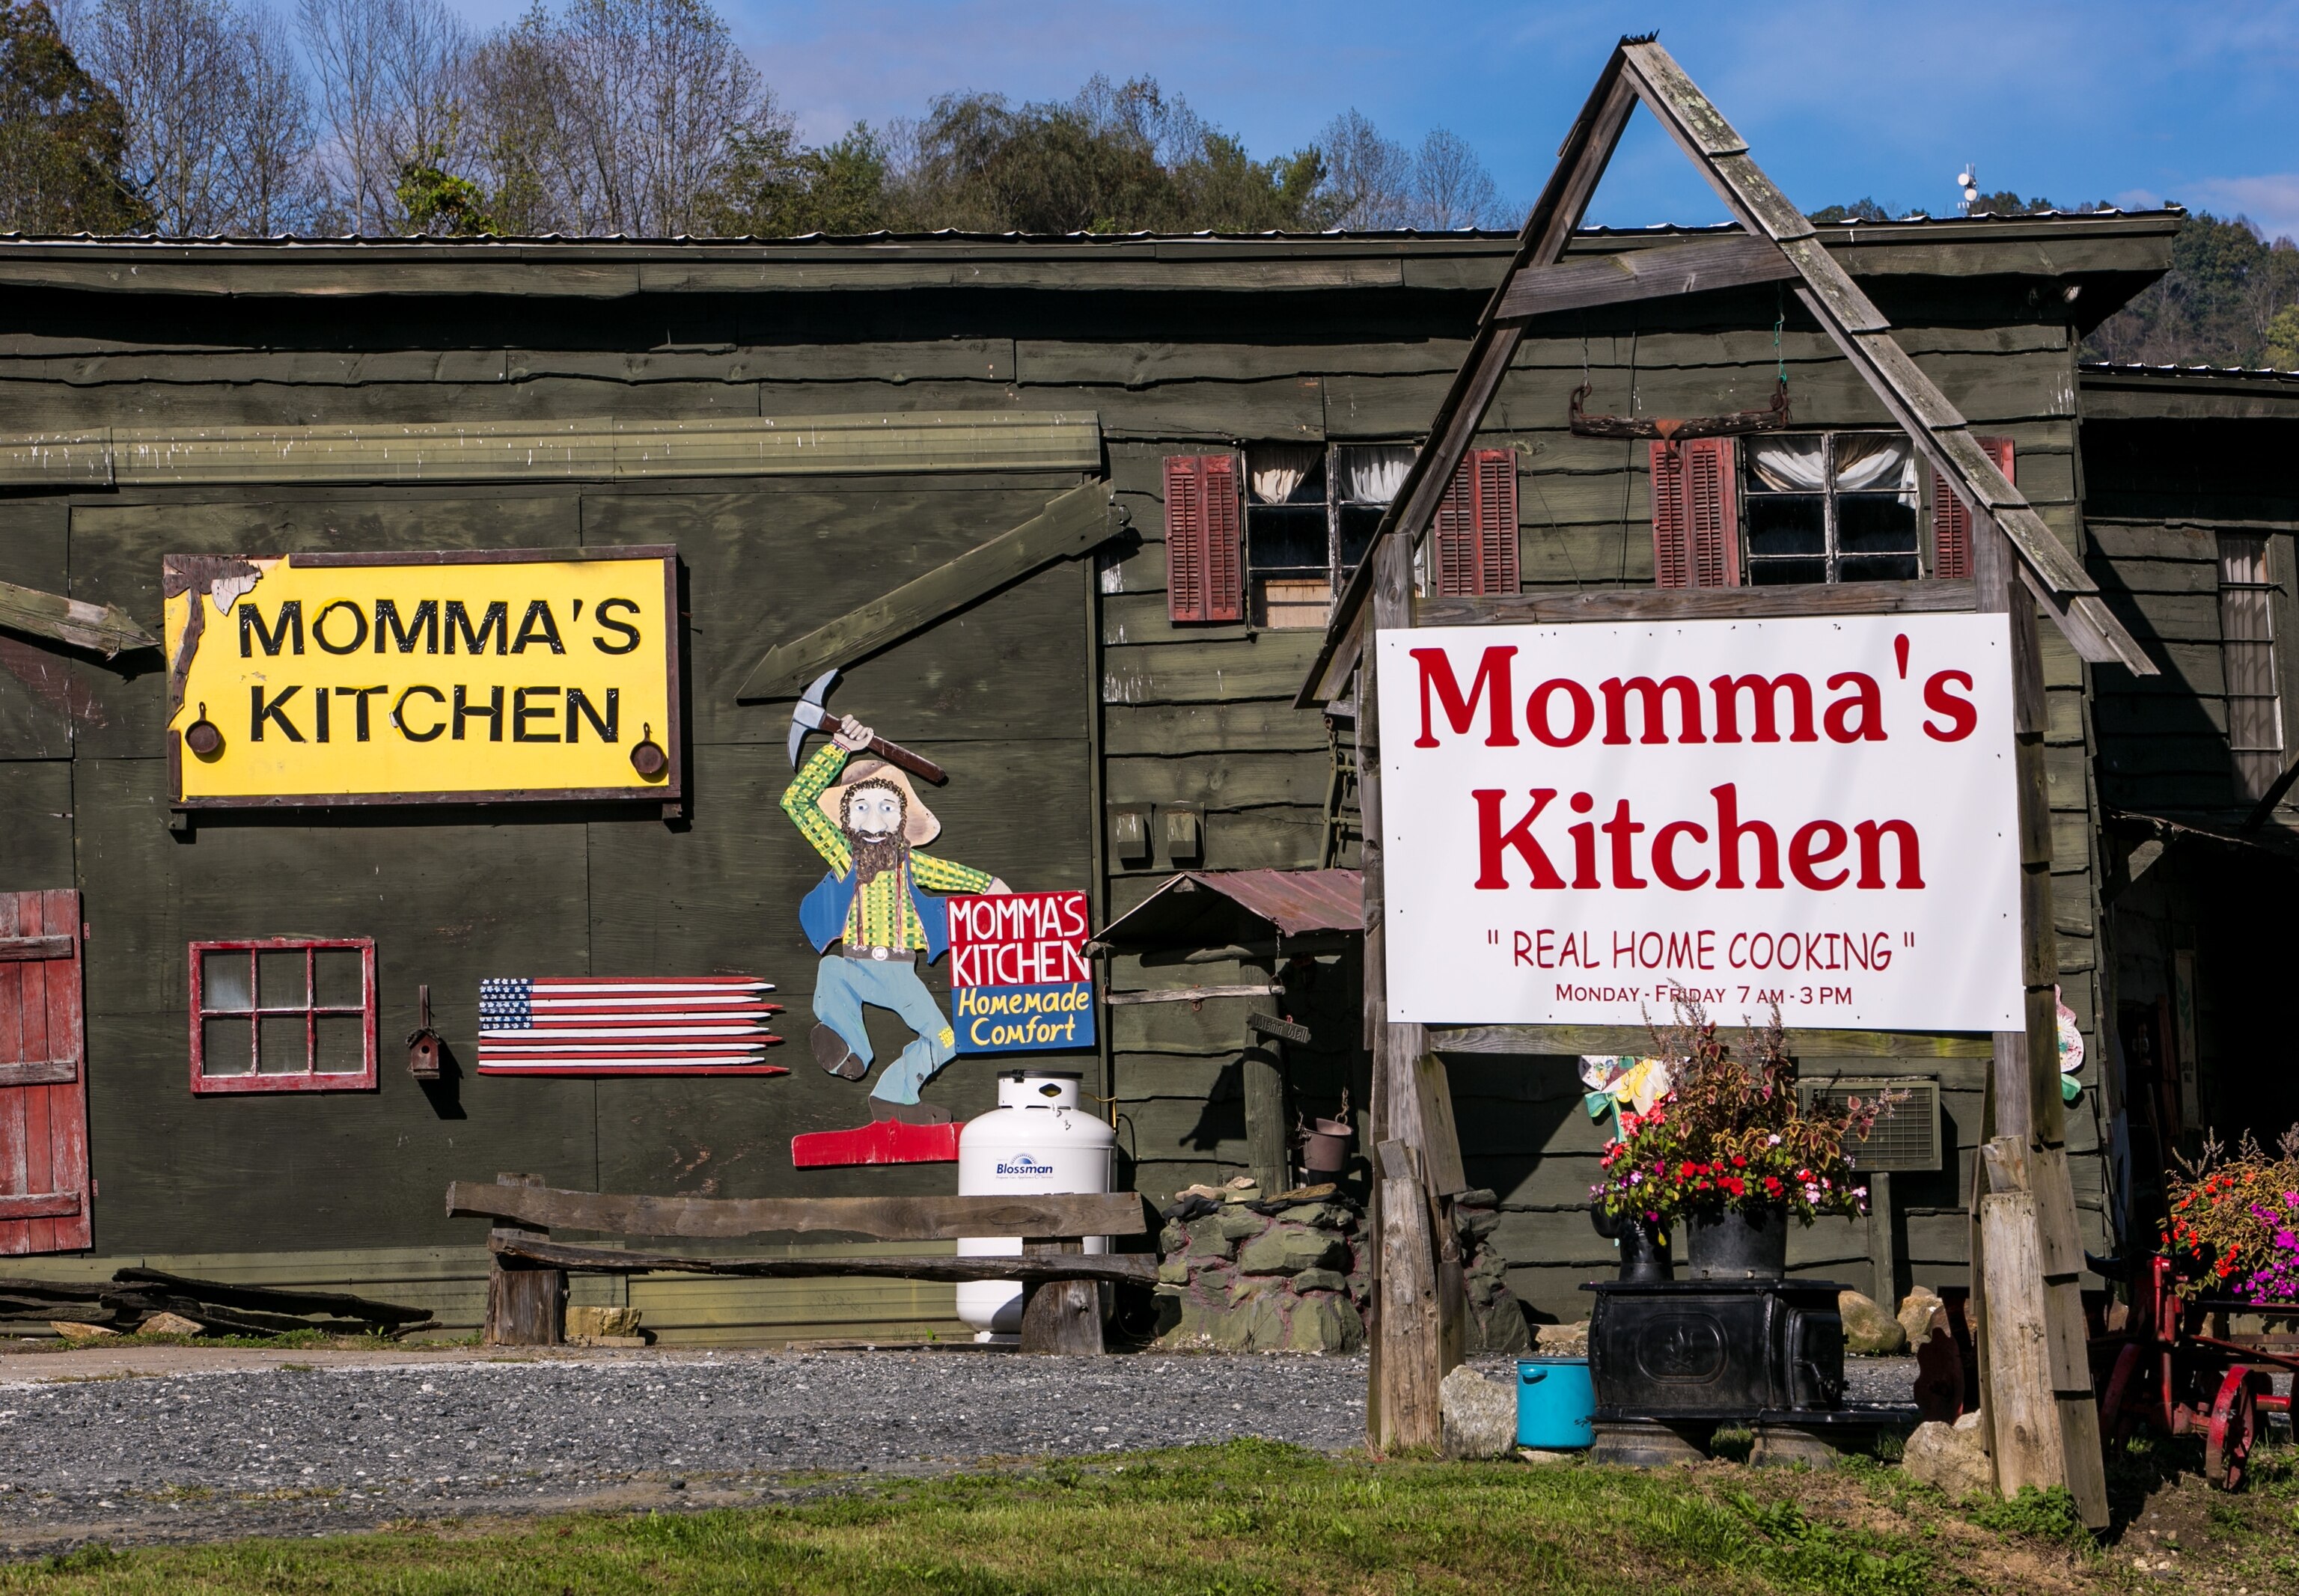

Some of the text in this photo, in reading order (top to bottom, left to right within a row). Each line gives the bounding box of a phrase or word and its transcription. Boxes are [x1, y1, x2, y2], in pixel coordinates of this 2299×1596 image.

[238, 597, 642, 658] MOMMA'S
[250, 684, 620, 744] KITCHEN
[1408, 633, 1978, 749] Momma's
[1471, 782, 1926, 892] Kitchen
[949, 896, 1085, 943] MOMMA'S
[951, 940, 1091, 988] KITCHEN
[1613, 929, 1717, 970] HOME
[1819, 986, 1852, 1005] PM
[971, 1014, 1076, 1047] Comfort
[1287, 1025, 1308, 1043] Well
[996, 1163, 1054, 1174] Blossman
